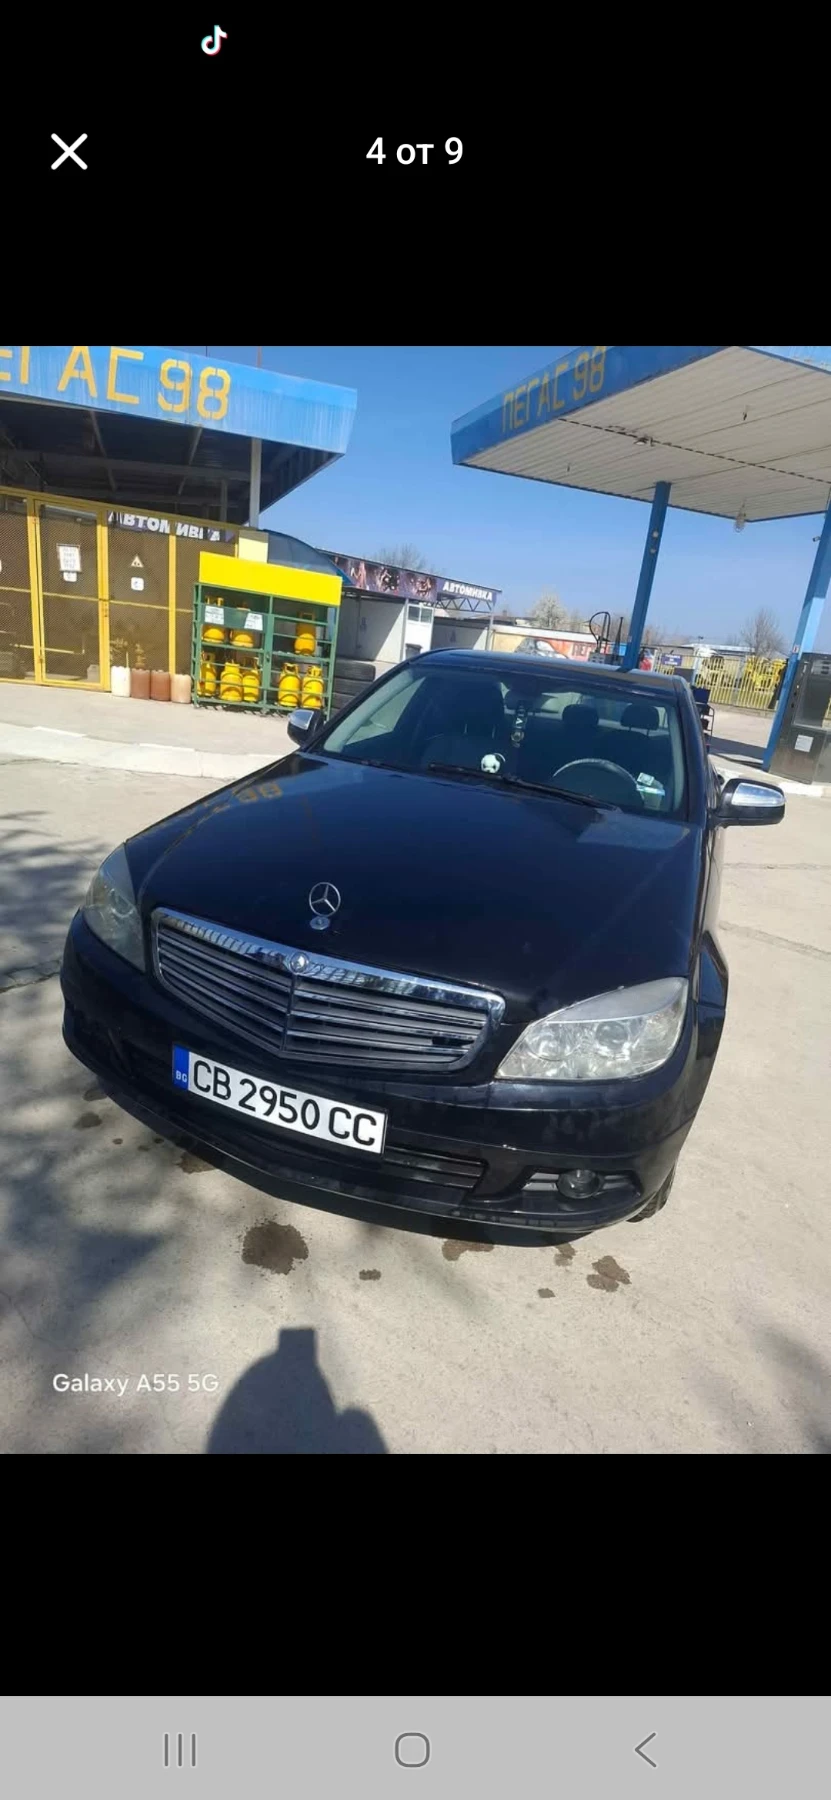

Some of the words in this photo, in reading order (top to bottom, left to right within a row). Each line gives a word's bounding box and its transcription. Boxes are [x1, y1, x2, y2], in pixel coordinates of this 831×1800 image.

[157, 358, 232, 421] 98
[502, 361, 569, 433] ПЕГАС
[572, 346, 607, 401] 98
[442, 581, 493, 602] АВТОМИВКА
[175, 1070, 188, 1083] BG
[193, 1060, 232, 1100] CB
[238, 1078, 321, 1130] 2950
[328, 1107, 377, 1146] CC
